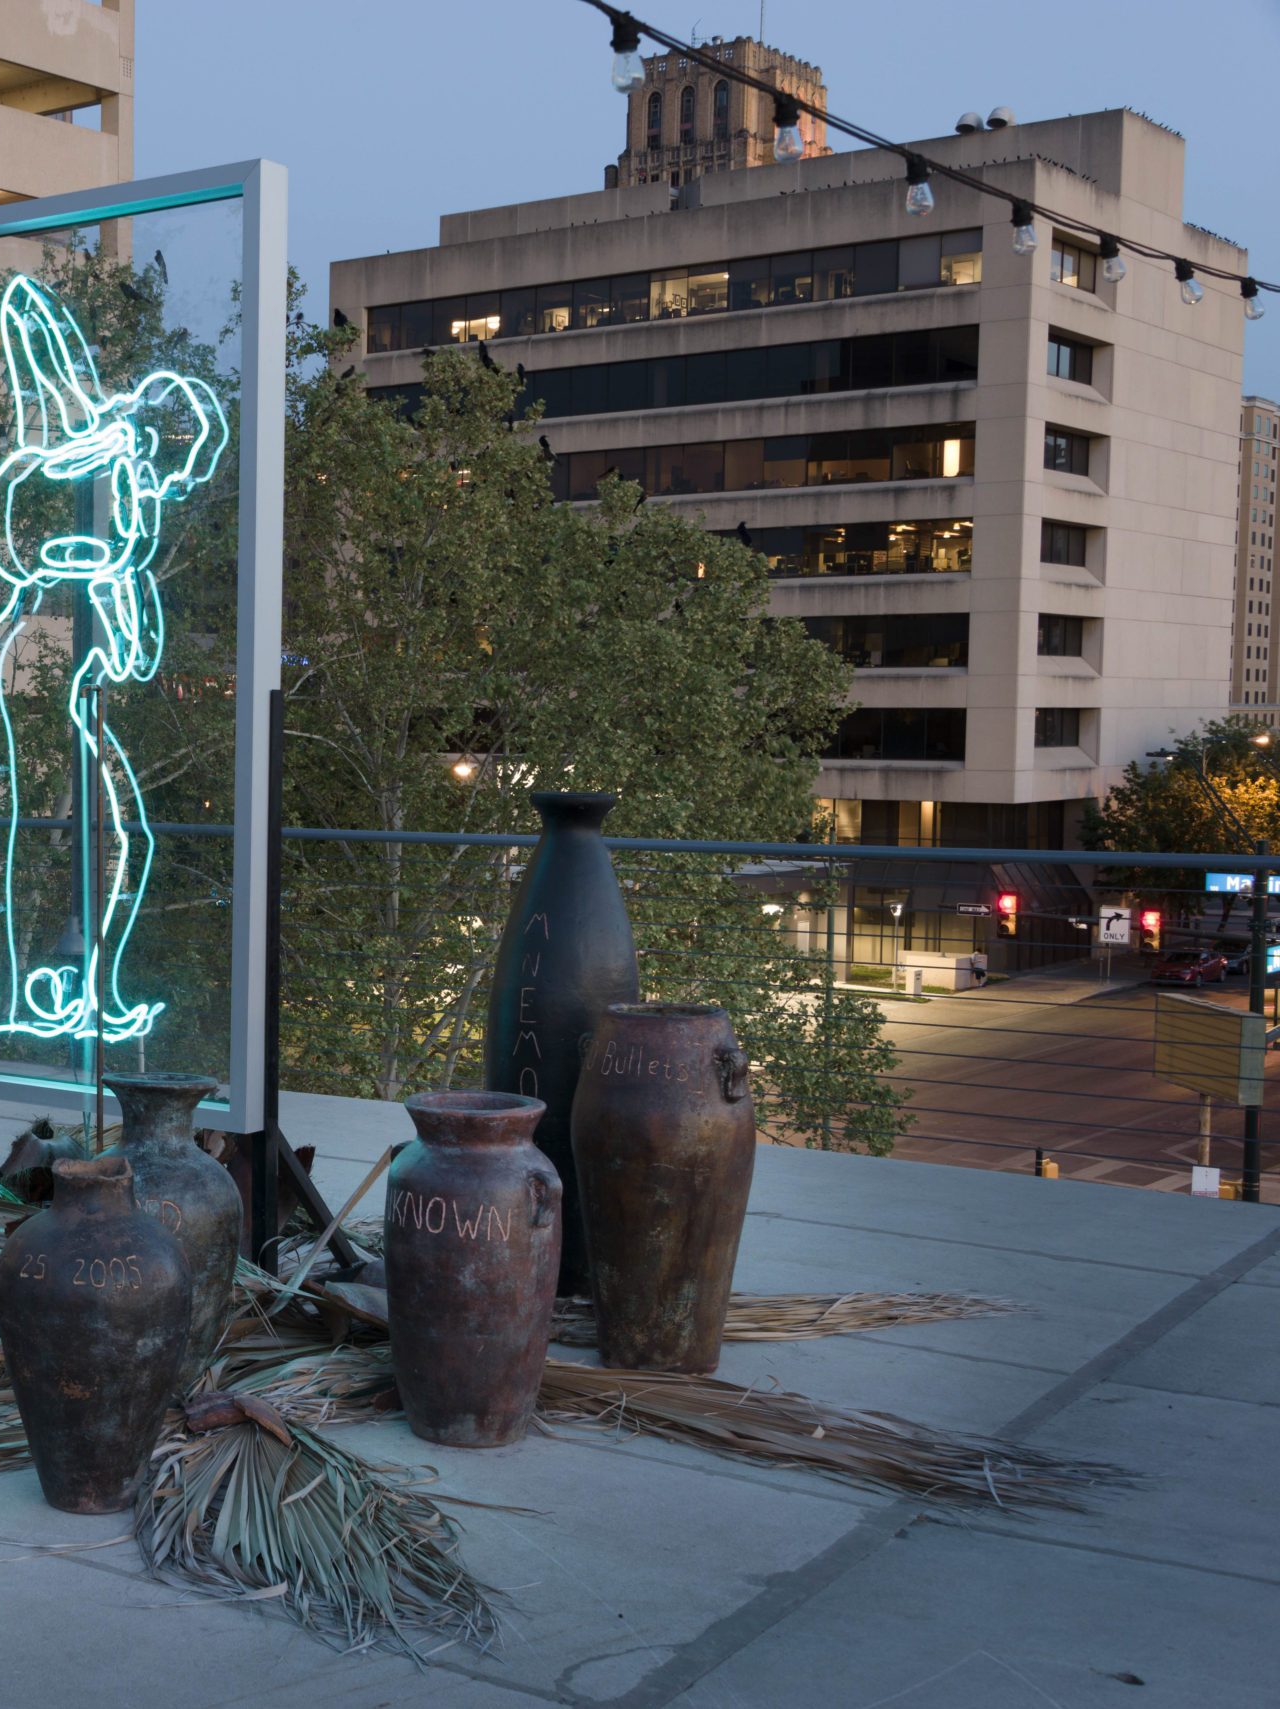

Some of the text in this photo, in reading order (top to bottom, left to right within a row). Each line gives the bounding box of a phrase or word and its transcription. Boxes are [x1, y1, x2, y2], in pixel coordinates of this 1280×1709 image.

[1103, 932, 1125, 941] ONLY
[20, 1253, 143, 1290] 25 2005
